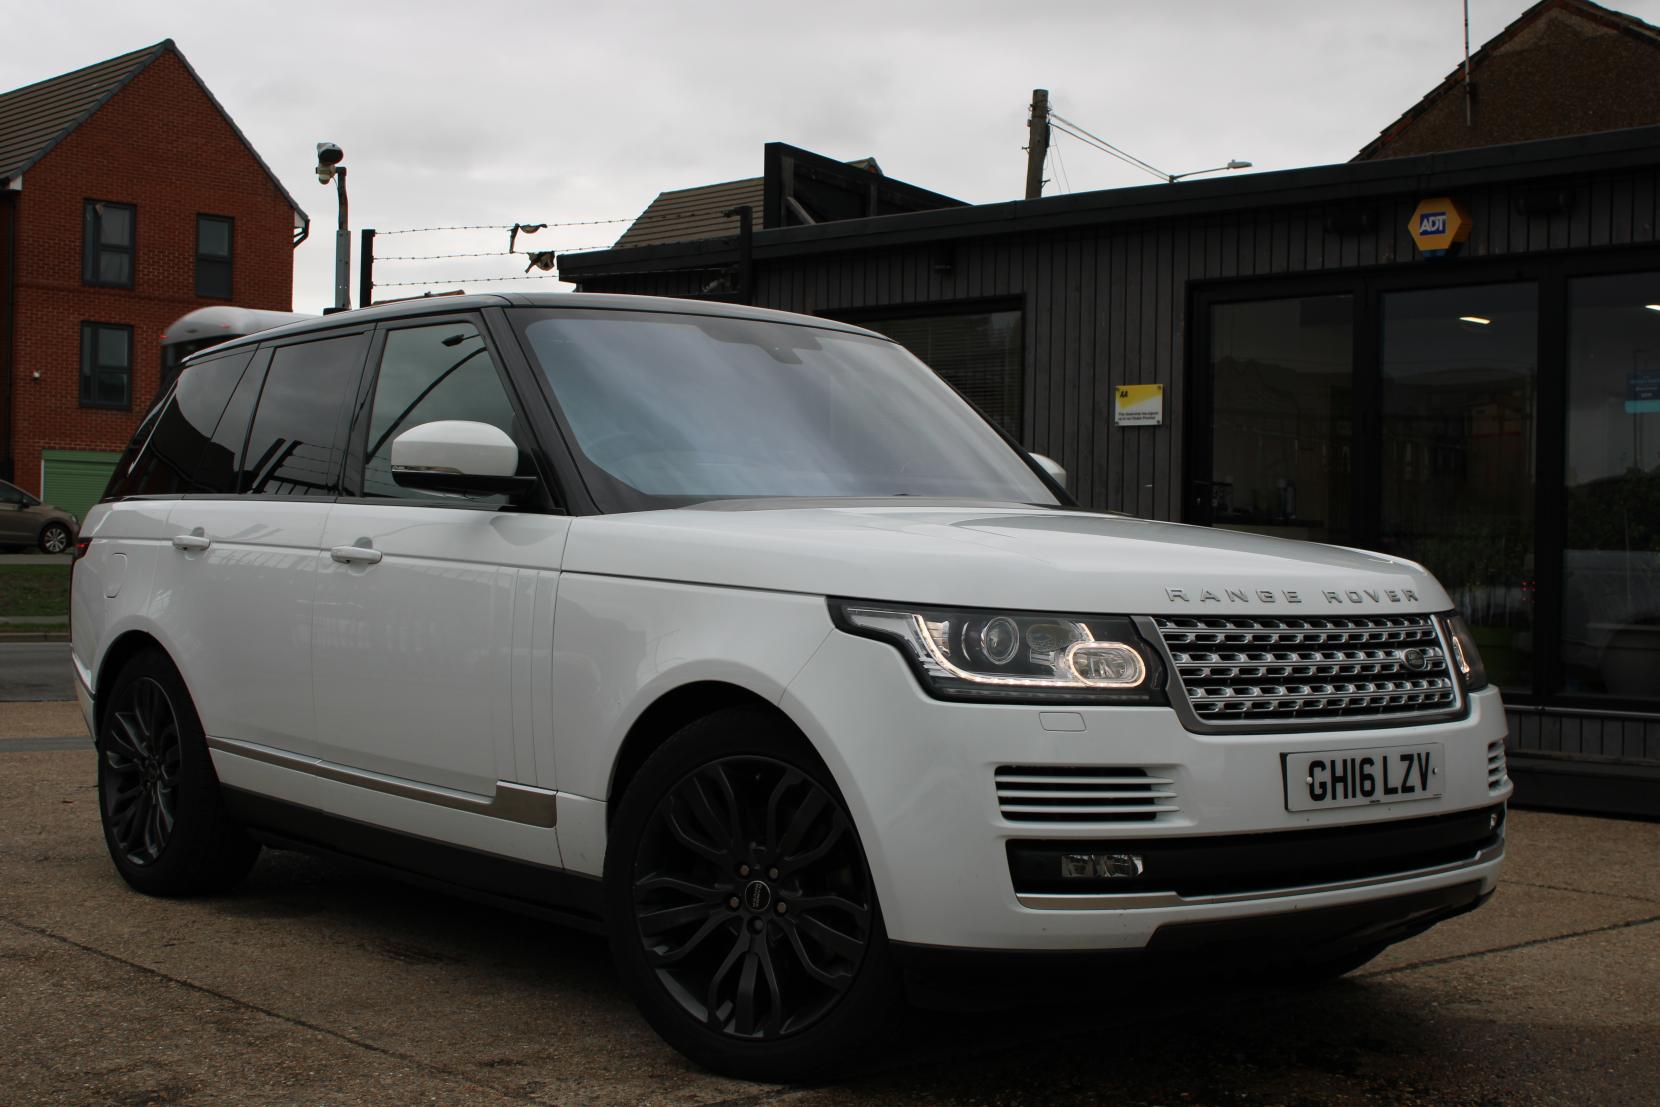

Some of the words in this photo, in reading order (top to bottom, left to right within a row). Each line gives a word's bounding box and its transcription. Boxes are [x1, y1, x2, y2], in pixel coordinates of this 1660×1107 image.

[1420, 216, 1447, 232] ADT
[1120, 390, 1128, 398] AA
[1165, 585, 1302, 603] RANGE
[1321, 589, 1419, 603] ROVER
[1308, 757, 1376, 802] GH16
[1382, 752, 1431, 796] LZV
